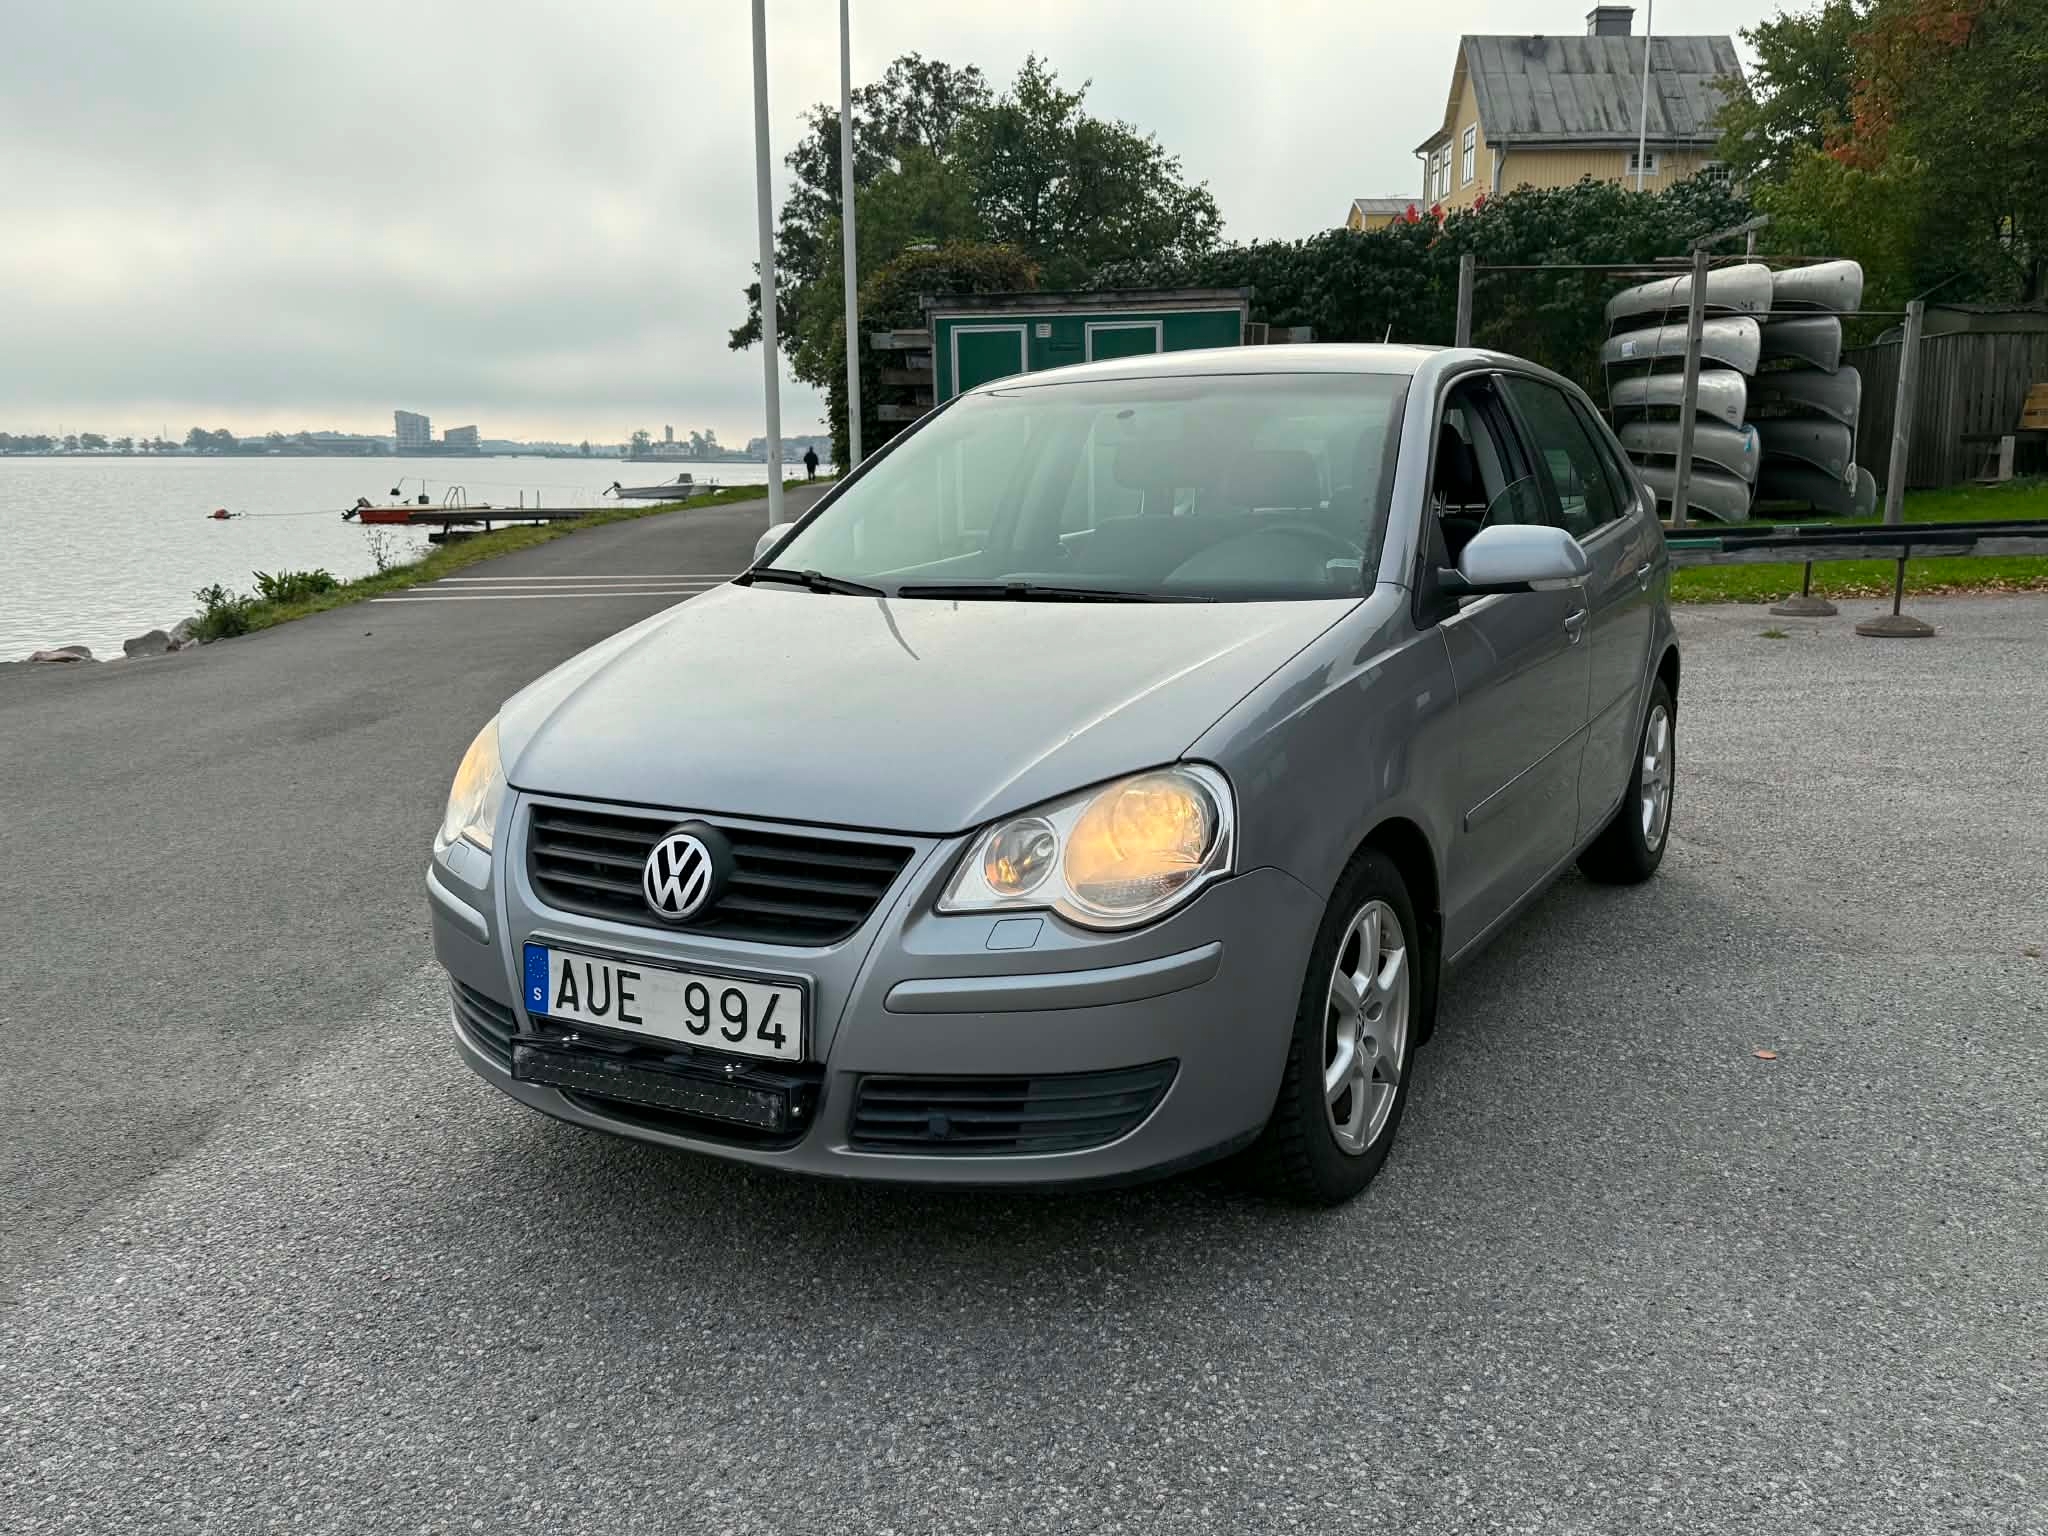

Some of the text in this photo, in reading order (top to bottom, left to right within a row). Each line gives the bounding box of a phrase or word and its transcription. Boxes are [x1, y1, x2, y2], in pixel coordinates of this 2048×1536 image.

[645, 836, 710, 916] VW
[533, 987, 542, 1000] S
[556, 959, 786, 1049] AUE 994
